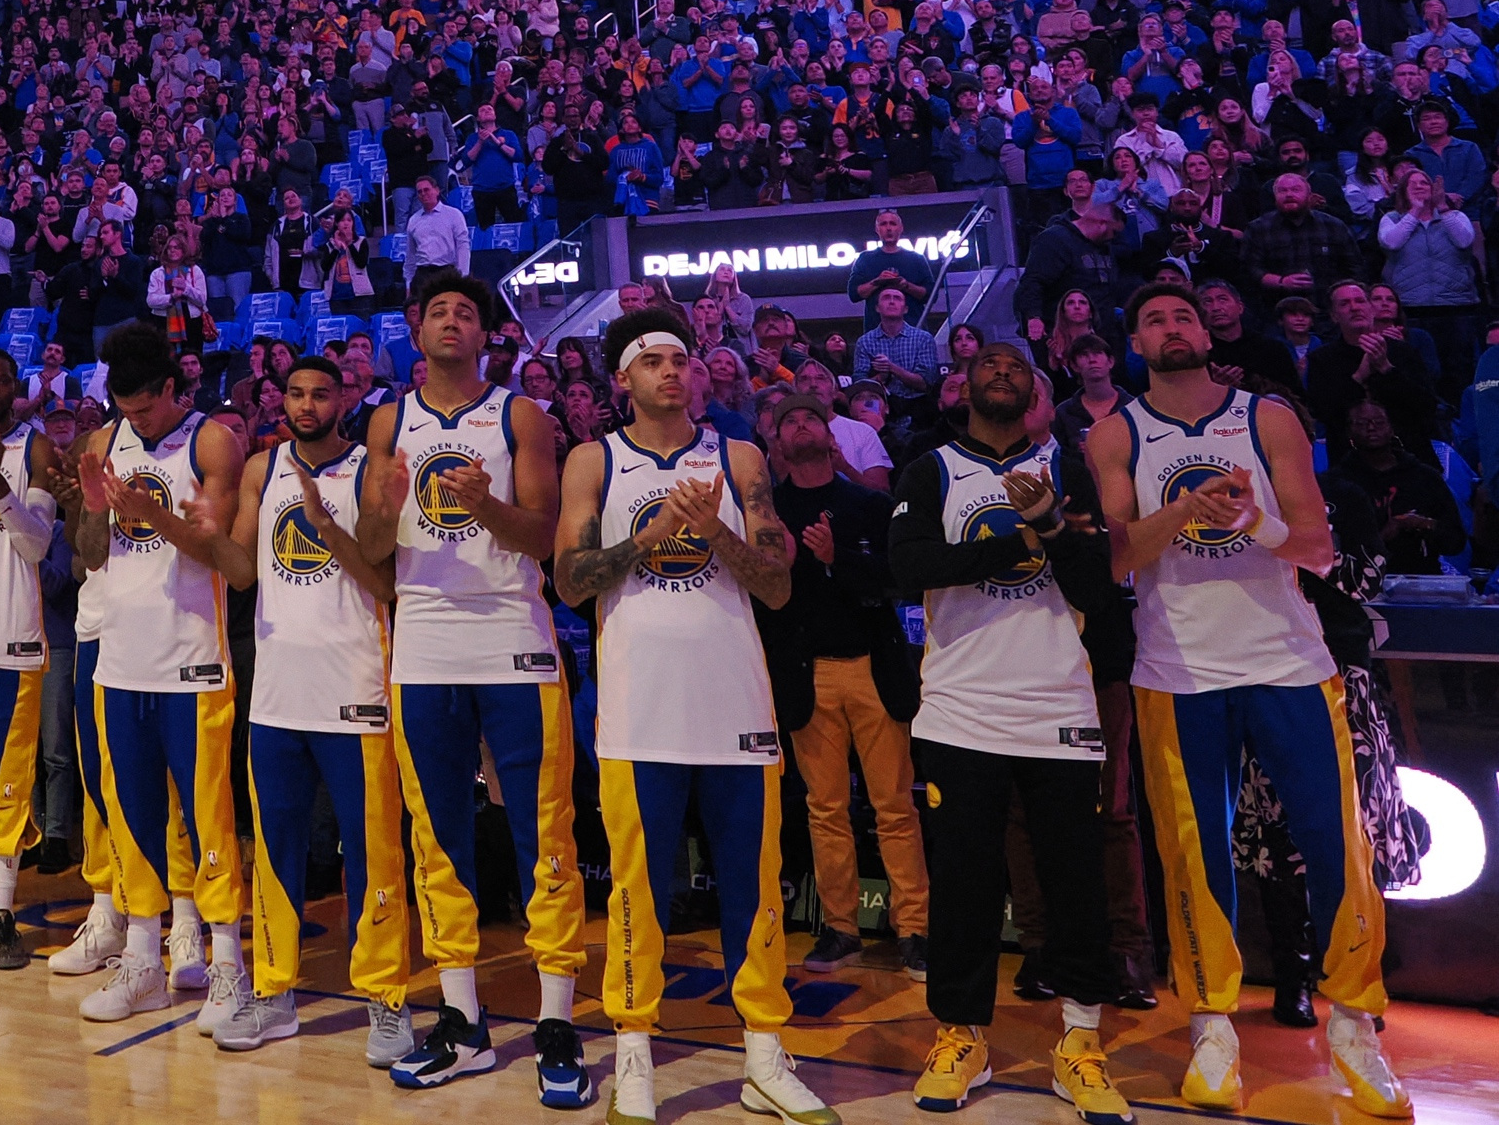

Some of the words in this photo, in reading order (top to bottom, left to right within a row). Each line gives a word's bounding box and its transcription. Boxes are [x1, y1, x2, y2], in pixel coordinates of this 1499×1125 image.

[642, 248, 761, 277] DEJAN
[765, 229, 969, 271] MILOVIĆ
[468, 419, 498, 428] Rakuten
[1213, 427, 1248, 437] Rakuten
[412, 442, 452, 469] GOLDEN
[684, 459, 717, 469] Rakuten
[1157, 453, 1203, 482] GOLDEN
[1208, 454, 1239, 471] STAT
[0, 466, 13, 481] ATE
[152, 465, 175, 486] STATE
[274, 493, 304, 515] GOLDE
[628, 487, 671, 514] GOLDEN
[959, 492, 1007, 519] GOLDEN
[112, 526, 167, 554] WARRIOR
[416, 514, 485, 543] WARRIO
[1171, 533, 1256, 560] ARRIOR
[270, 558, 340, 587] WARRIORS
[635, 561, 720, 593] WARRIORS
[974, 570, 1053, 601] ARRIORS
[1383, 765, 1499, 901] D
[620, 887, 632, 927] GOLDEN
[1180, 889, 1195, 930] GOLDEN
[623, 927, 633, 956] STATE
[1187, 929, 1199, 956] STATE
[623, 959, 634, 1011] WARRIORS
